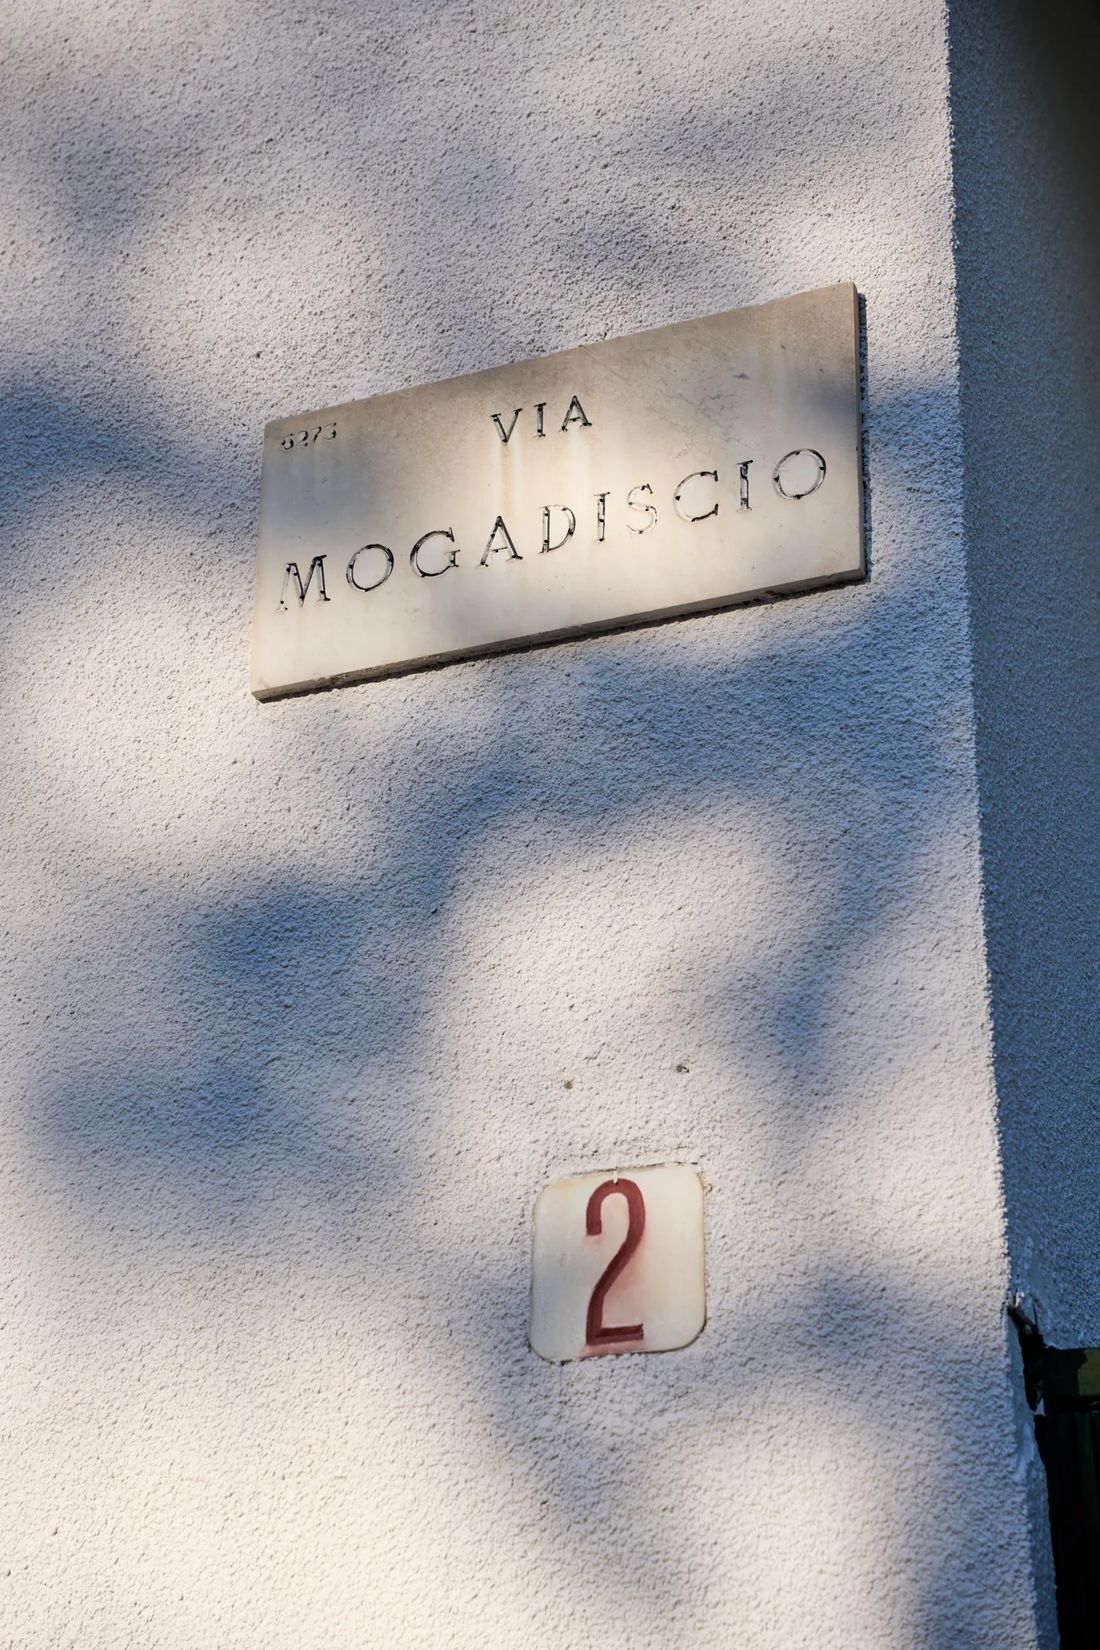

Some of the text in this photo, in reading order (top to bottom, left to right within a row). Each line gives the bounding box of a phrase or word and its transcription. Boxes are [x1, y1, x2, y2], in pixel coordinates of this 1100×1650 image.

[490, 395, 593, 446] VIA
[276, 448, 827, 613] MOGADISCIO
[585, 1178, 646, 1346] 2
